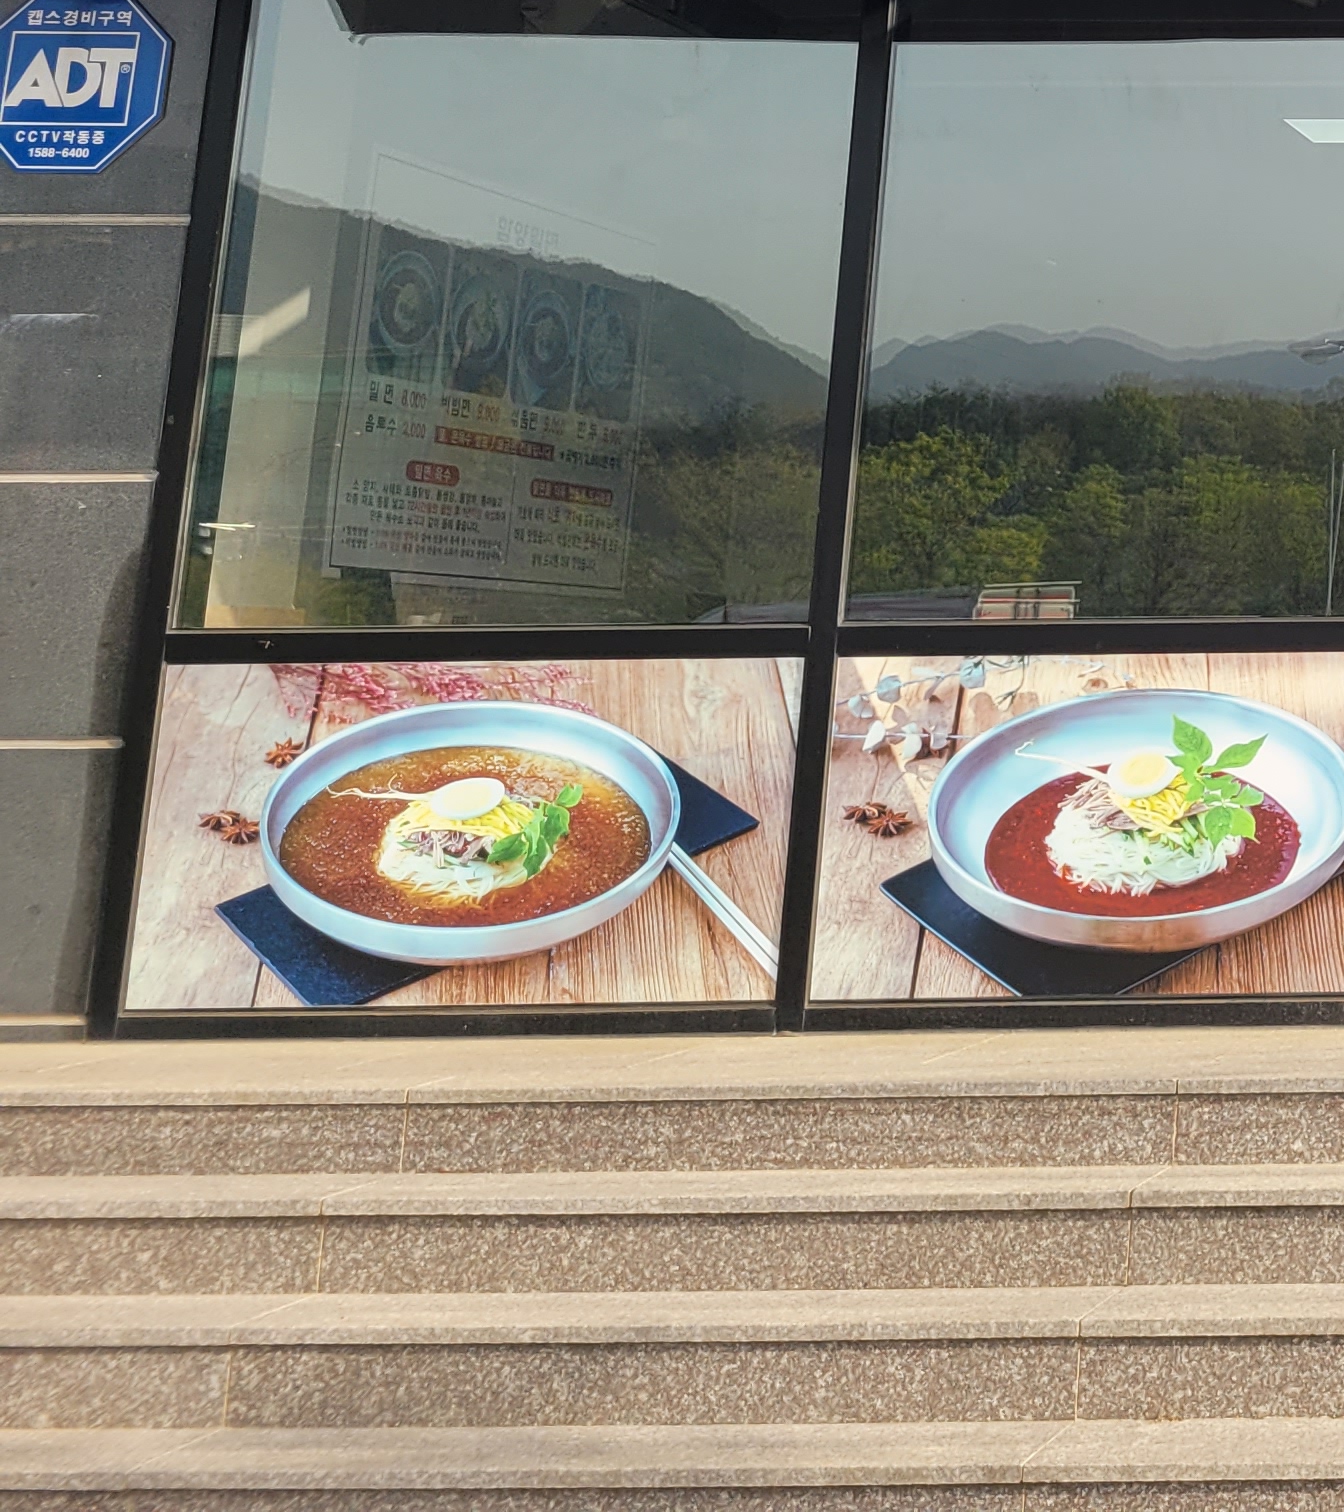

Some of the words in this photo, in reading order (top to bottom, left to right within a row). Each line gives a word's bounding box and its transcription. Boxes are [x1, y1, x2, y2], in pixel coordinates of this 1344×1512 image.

[27, 9, 133, 27] 캡스경비구역
[3, 47, 137, 108] ADT
[15, 130, 106, 145] CCTV작동중
[28, 147, 90, 158] 1588-6400
